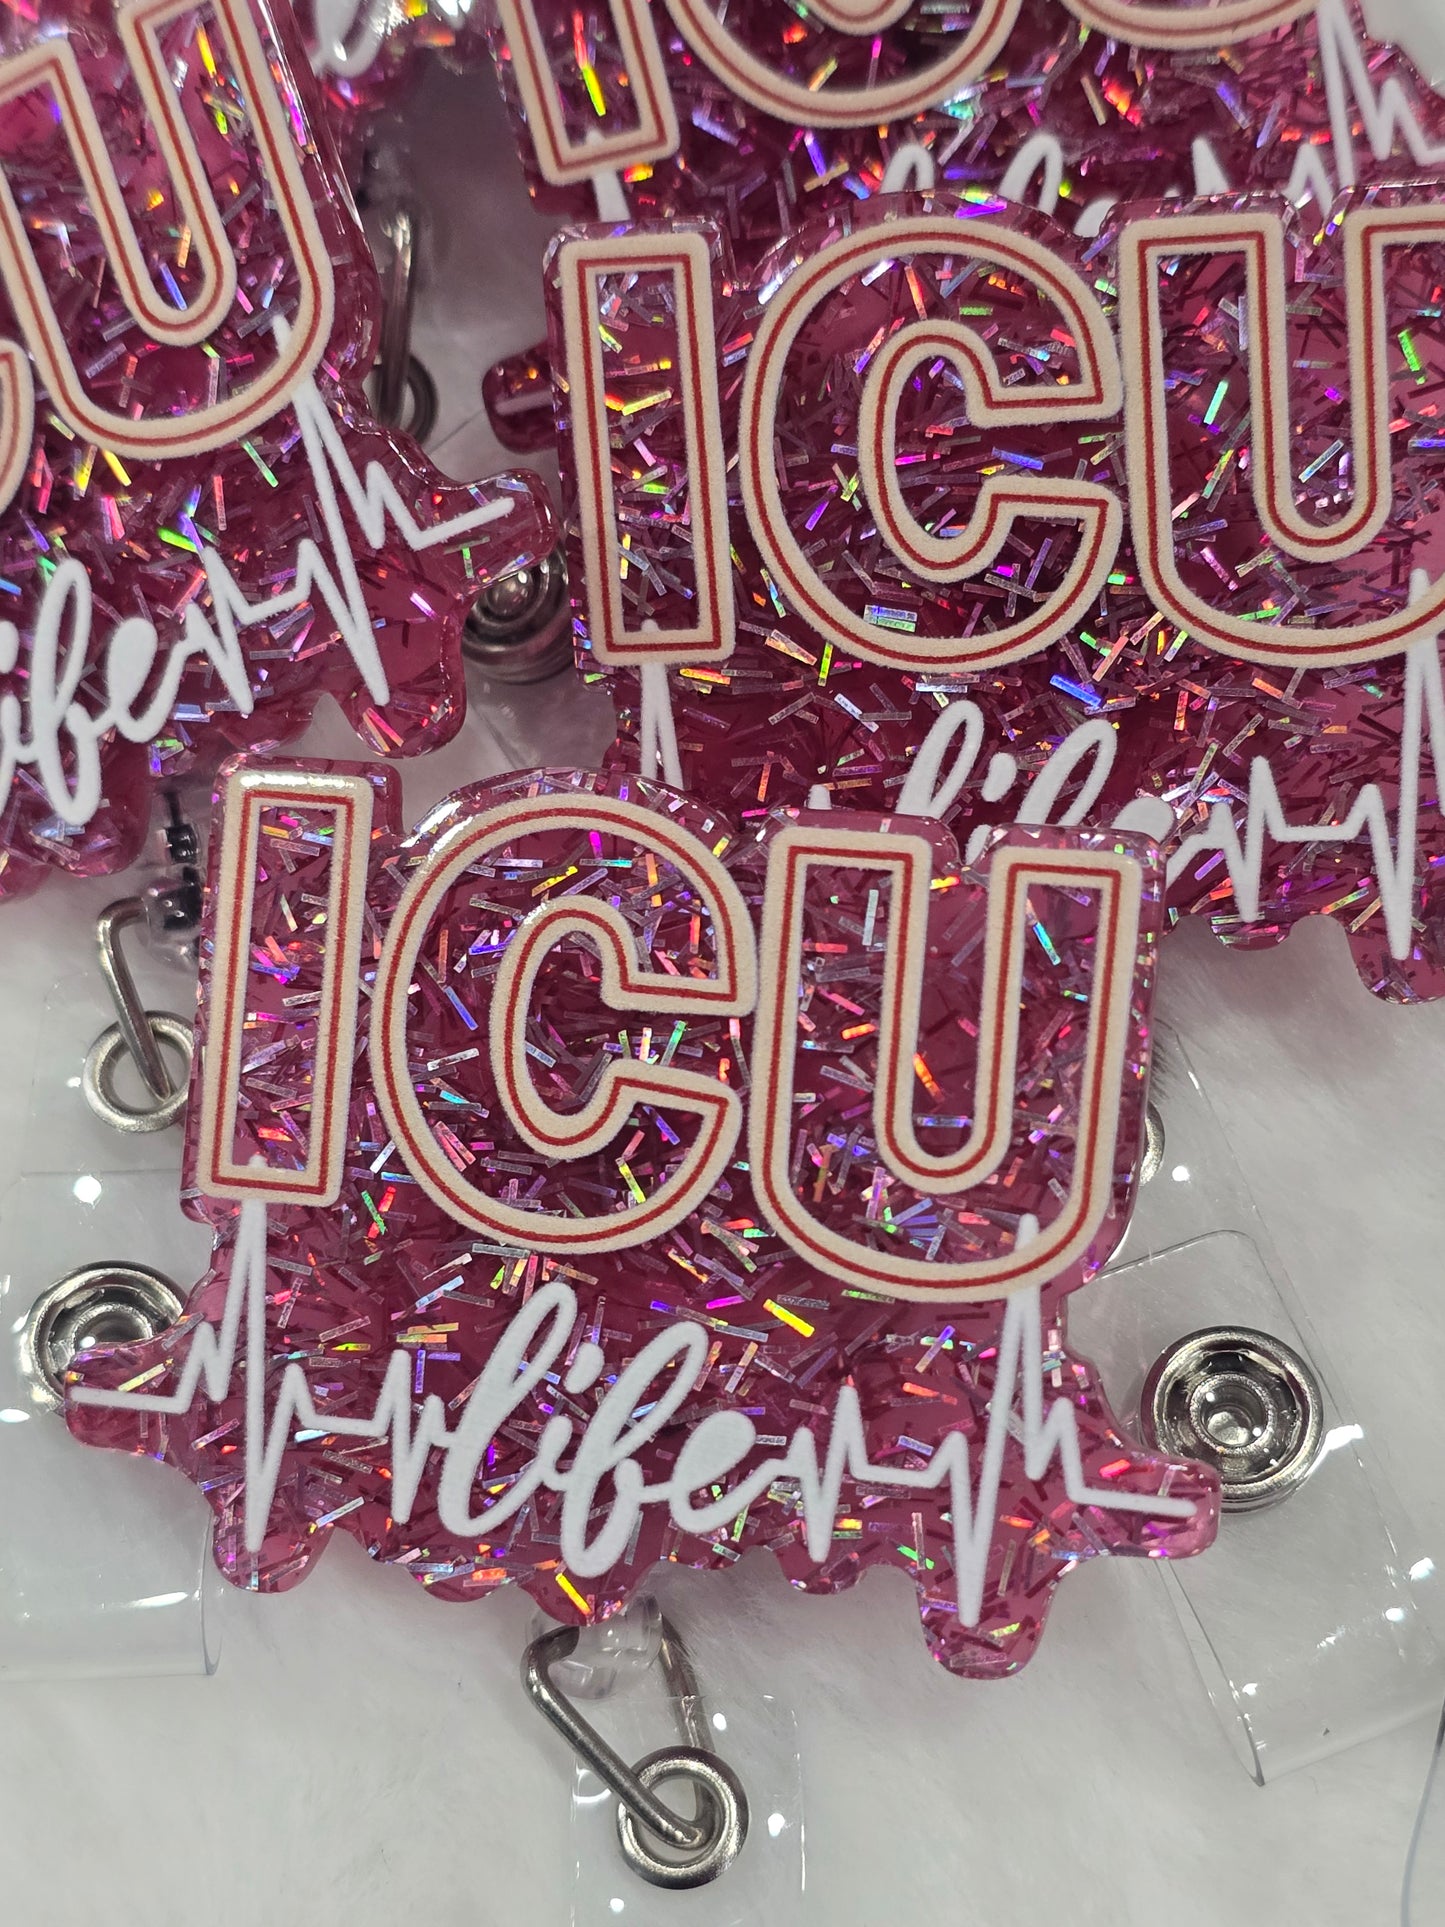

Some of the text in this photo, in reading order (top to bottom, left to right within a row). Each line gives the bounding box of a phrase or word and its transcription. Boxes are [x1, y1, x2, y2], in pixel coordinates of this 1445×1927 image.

[558, 203, 1445, 671] ICU
[196, 769, 1138, 1302] ICU
[438, 1281, 780, 1578] life
